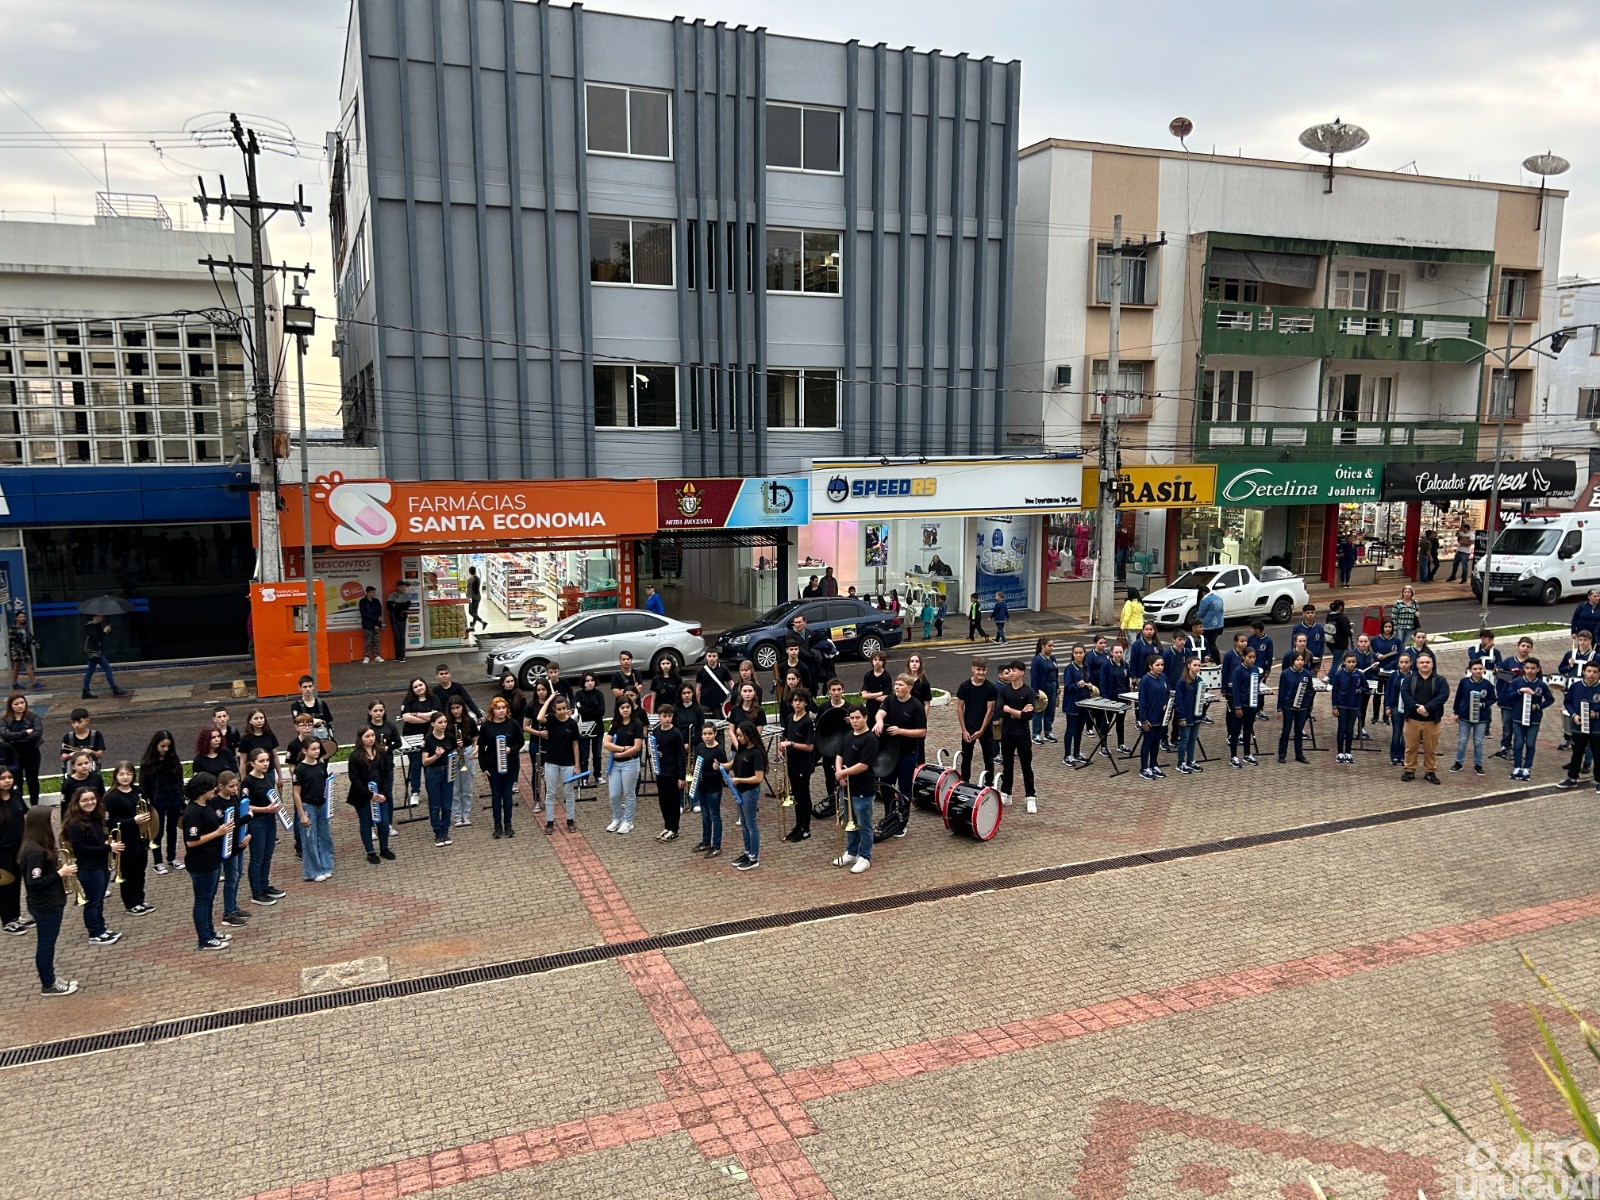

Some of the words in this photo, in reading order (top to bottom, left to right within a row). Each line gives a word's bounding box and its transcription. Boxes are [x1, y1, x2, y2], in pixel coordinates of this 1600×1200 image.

[1335, 464, 1362, 479] Ótica
[1364, 468, 1373, 479] &
[1416, 471, 1466, 494] Calçados
[1115, 477, 1197, 503] RASIL
[1222, 468, 1318, 502] Getelina
[1327, 484, 1375, 497] Joalheria
[408, 491, 526, 513] FARMÁCIAS
[409, 515, 485, 533] SANTA
[493, 511, 606, 530] ECONOMIA
[313, 559, 372, 569] DESCONTOS
